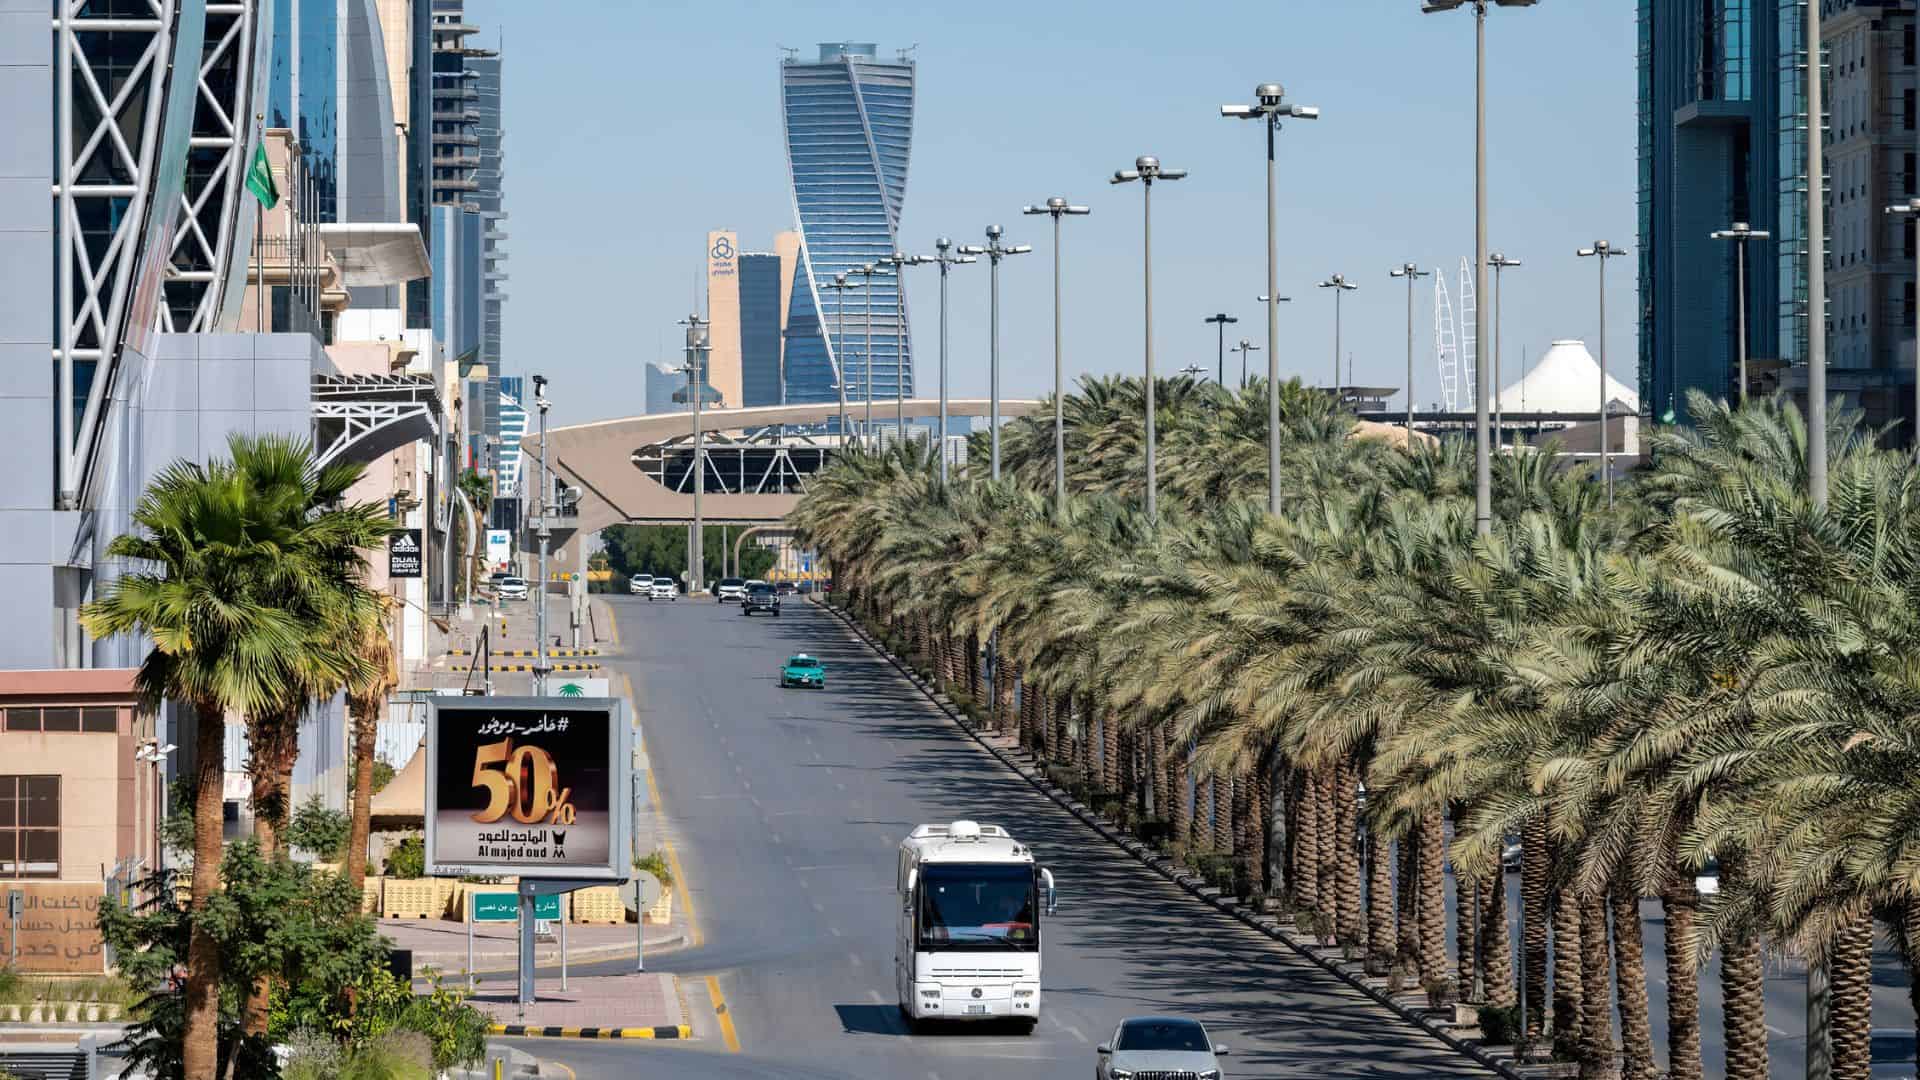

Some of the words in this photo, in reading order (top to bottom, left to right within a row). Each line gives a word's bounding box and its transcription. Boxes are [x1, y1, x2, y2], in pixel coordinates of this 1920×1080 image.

[470, 736, 577, 825] 50%
[478, 830, 510, 844] للعود
[511, 830, 547, 846] الماجد
[478, 845, 488, 857] Al
[491, 845, 523, 860] majed
[526, 846, 547, 858] oud
[65, 938, 101, 966] في
